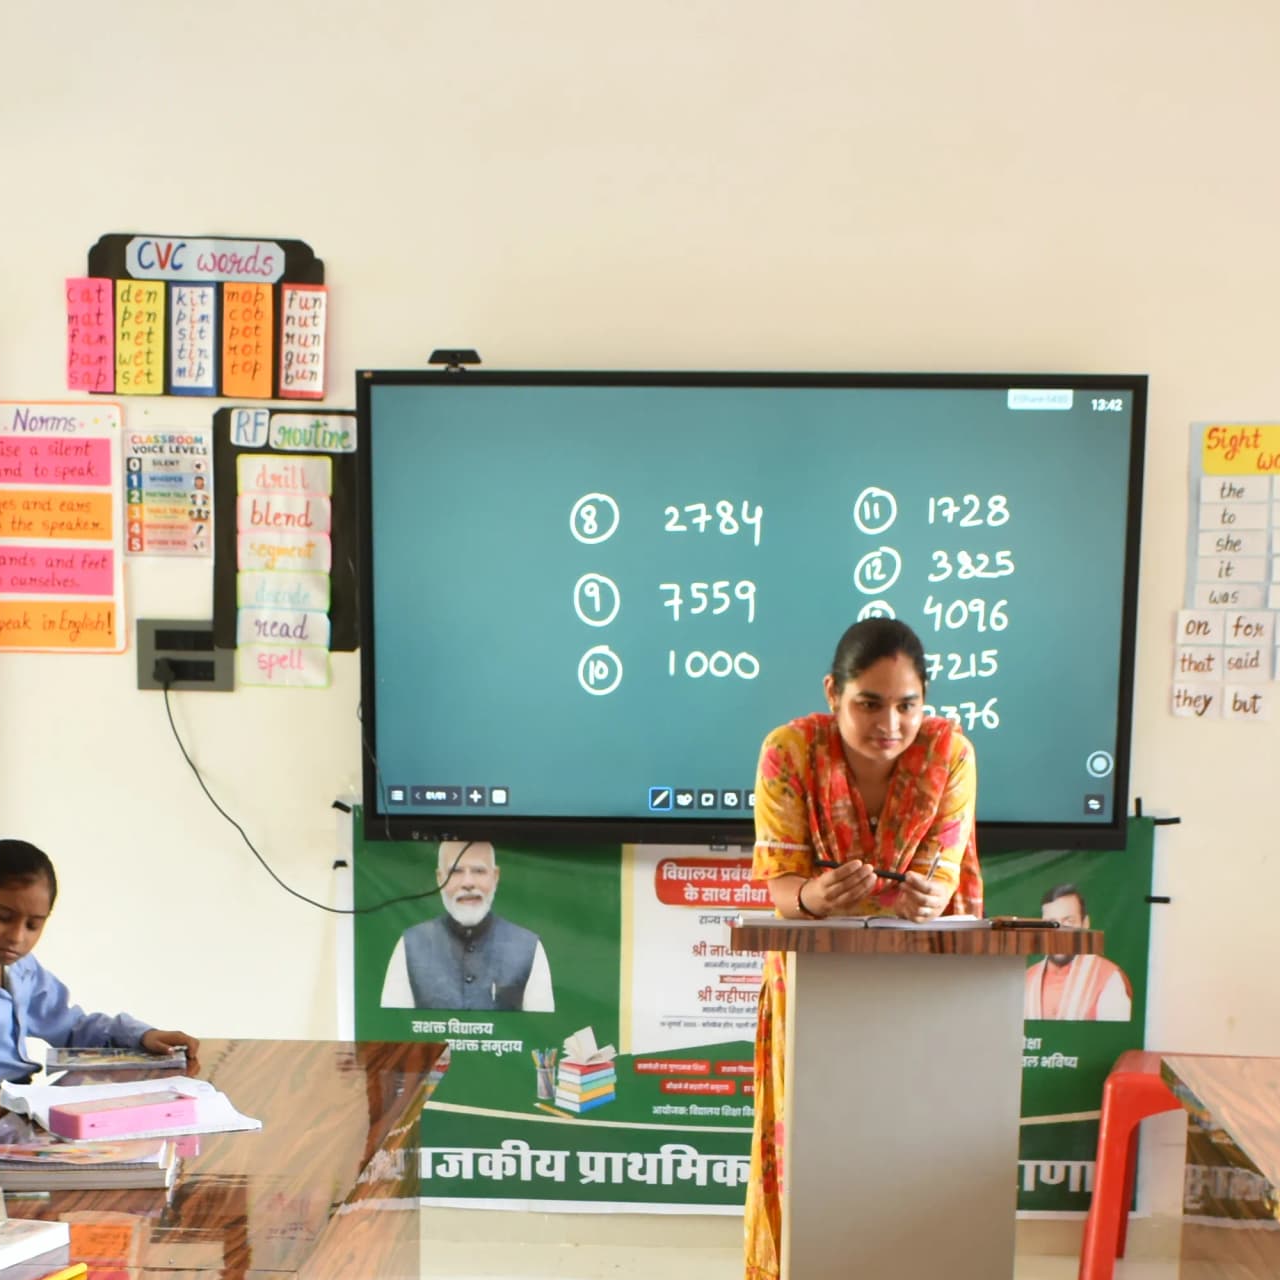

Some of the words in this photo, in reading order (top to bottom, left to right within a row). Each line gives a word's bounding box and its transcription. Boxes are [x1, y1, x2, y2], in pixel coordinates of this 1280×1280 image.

[137, 241, 187, 271] CVC
[197, 244, 275, 276] words
[67, 284, 104, 304] cat
[120, 284, 158, 304] den
[177, 288, 208, 306] kit
[227, 285, 265, 306] mop
[288, 291, 322, 310] fun
[68, 308, 104, 327] mat
[121, 306, 157, 328] pen
[286, 311, 320, 328] nut
[121, 327, 155, 346] net
[178, 324, 207, 341] sit
[229, 324, 262, 340] pot
[285, 332, 321, 348] run
[119, 347, 153, 366] wet
[177, 343, 208, 361] tin
[285, 350, 319, 370] gun
[121, 369, 153, 385] set
[231, 359, 262, 381] top
[284, 368, 318, 385] bun
[13, 408, 76, 432] Norms
[236, 410, 267, 443] RF
[274, 419, 352, 449] routine
[30, 447, 38, 457] a
[48, 440, 92, 457] silent
[131, 435, 203, 445] CLASSROOM
[132, 444, 164, 455] VOICE
[169, 445, 207, 455] LEVELS
[1207, 427, 1262, 461] Sight
[34, 463, 48, 477] to
[129, 458, 140, 471] 0
[130, 475, 138, 488] 1
[256, 463, 309, 489] drill
[130, 490, 140, 503] 2
[1220, 481, 1245, 500] the
[22, 498, 51, 511] and
[60, 501, 92, 512] ears
[250, 499, 313, 528] blend
[928, 494, 1010, 527] 1728
[11, 515, 33, 531] the
[664, 499, 763, 547] 2784
[1221, 508, 1236, 525] to
[130, 523, 141, 535] 4
[130, 537, 141, 551] 5
[1215, 533, 1242, 553] she
[45, 554, 75, 569] and
[81, 553, 108, 569] feet
[249, 540, 317, 570] segment
[928, 550, 1015, 582] 3825
[1217, 560, 1235, 579] it
[659, 580, 757, 624] 7559
[1208, 590, 1239, 605] was
[923, 595, 1009, 633] 4096
[42, 613, 56, 631] in
[59, 608, 112, 643] English!
[254, 613, 309, 640] read
[1185, 619, 1211, 636] on
[1232, 615, 1265, 638] for
[257, 648, 305, 680] spell
[669, 650, 760, 680] 1000
[924, 649, 999, 681] 7215
[1180, 652, 1215, 672] that
[1227, 649, 1260, 670] said
[1174, 689, 1213, 717] they
[1231, 692, 1263, 714] but
[663, 862, 717, 881] विद्यालय
[684, 882, 700, 902] के
[702, 886, 731, 903] साथ
[734, 884, 768, 903] सीधा
[692, 941, 707, 957] श्री
[698, 986, 712, 1002] श्री
[412, 1020, 447, 1034] सशक्त
[448, 1018, 494, 1035] विद्यालय
[481, 1039, 523, 1057] समुदाय
[418, 1139, 570, 1182] ाजकीय
